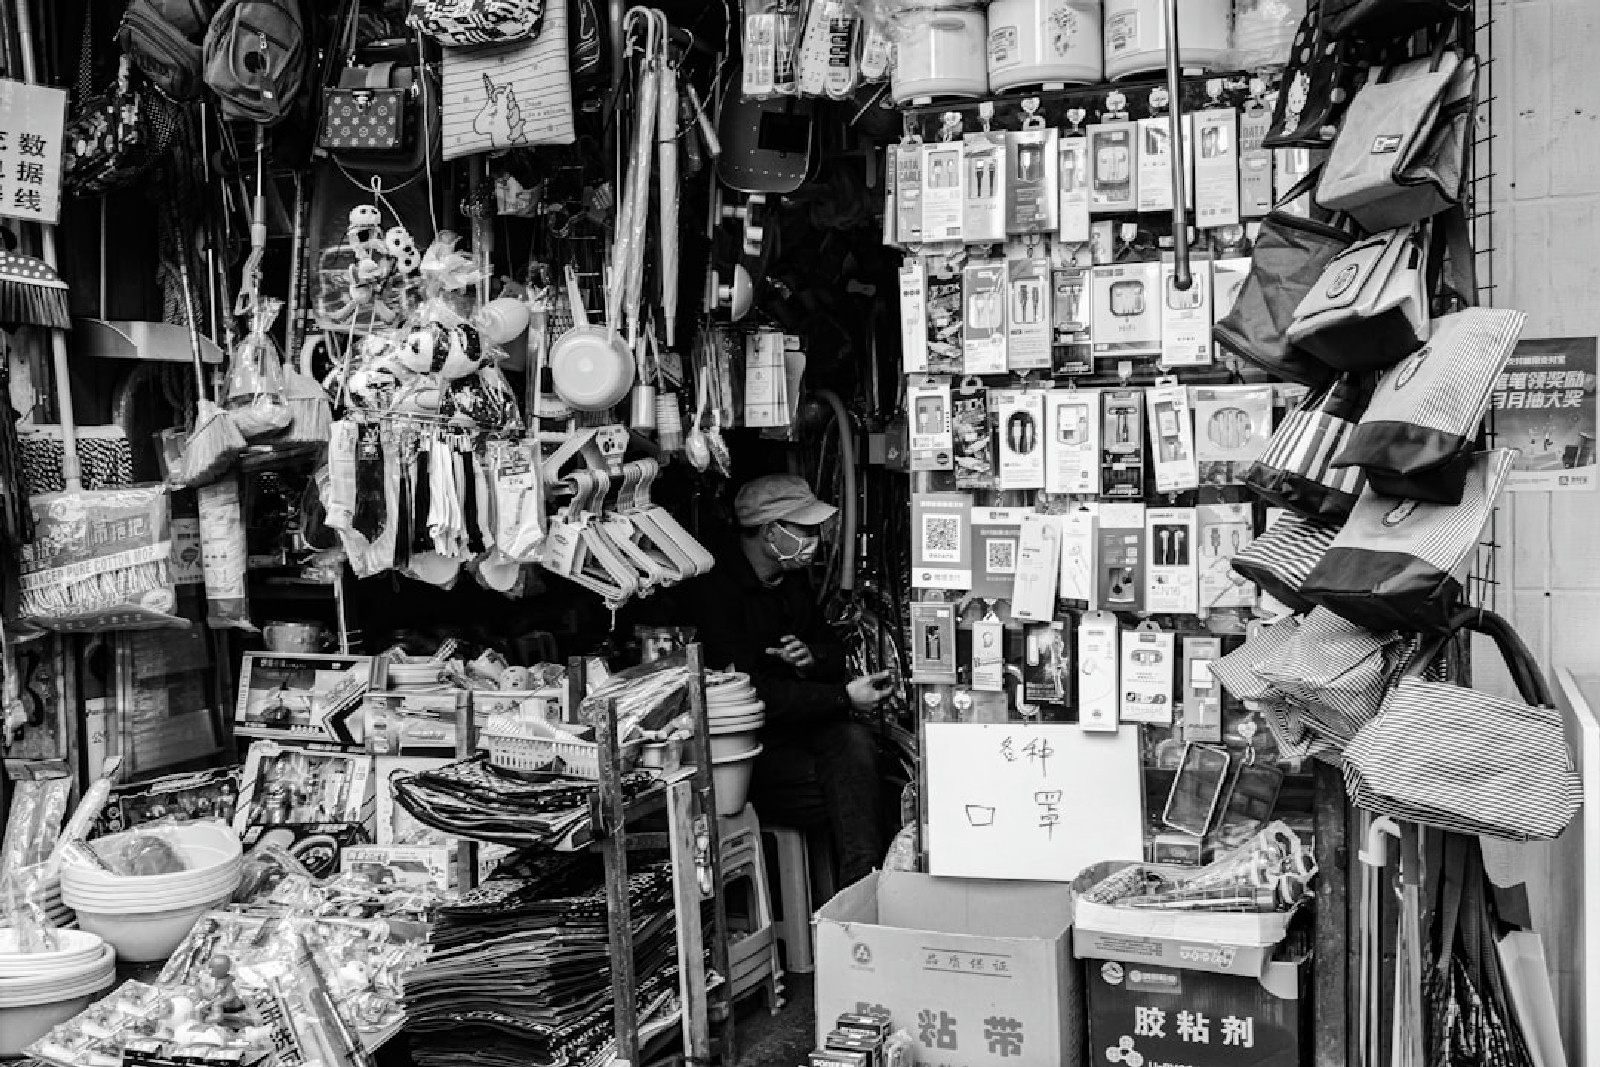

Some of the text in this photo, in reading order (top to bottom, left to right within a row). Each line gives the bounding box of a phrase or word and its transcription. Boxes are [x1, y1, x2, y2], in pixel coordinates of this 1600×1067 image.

[14, 132, 47, 212] 数据线
[965, 789, 1063, 842] 口罩
[1133, 1005, 1256, 1049] 胶粘剂
